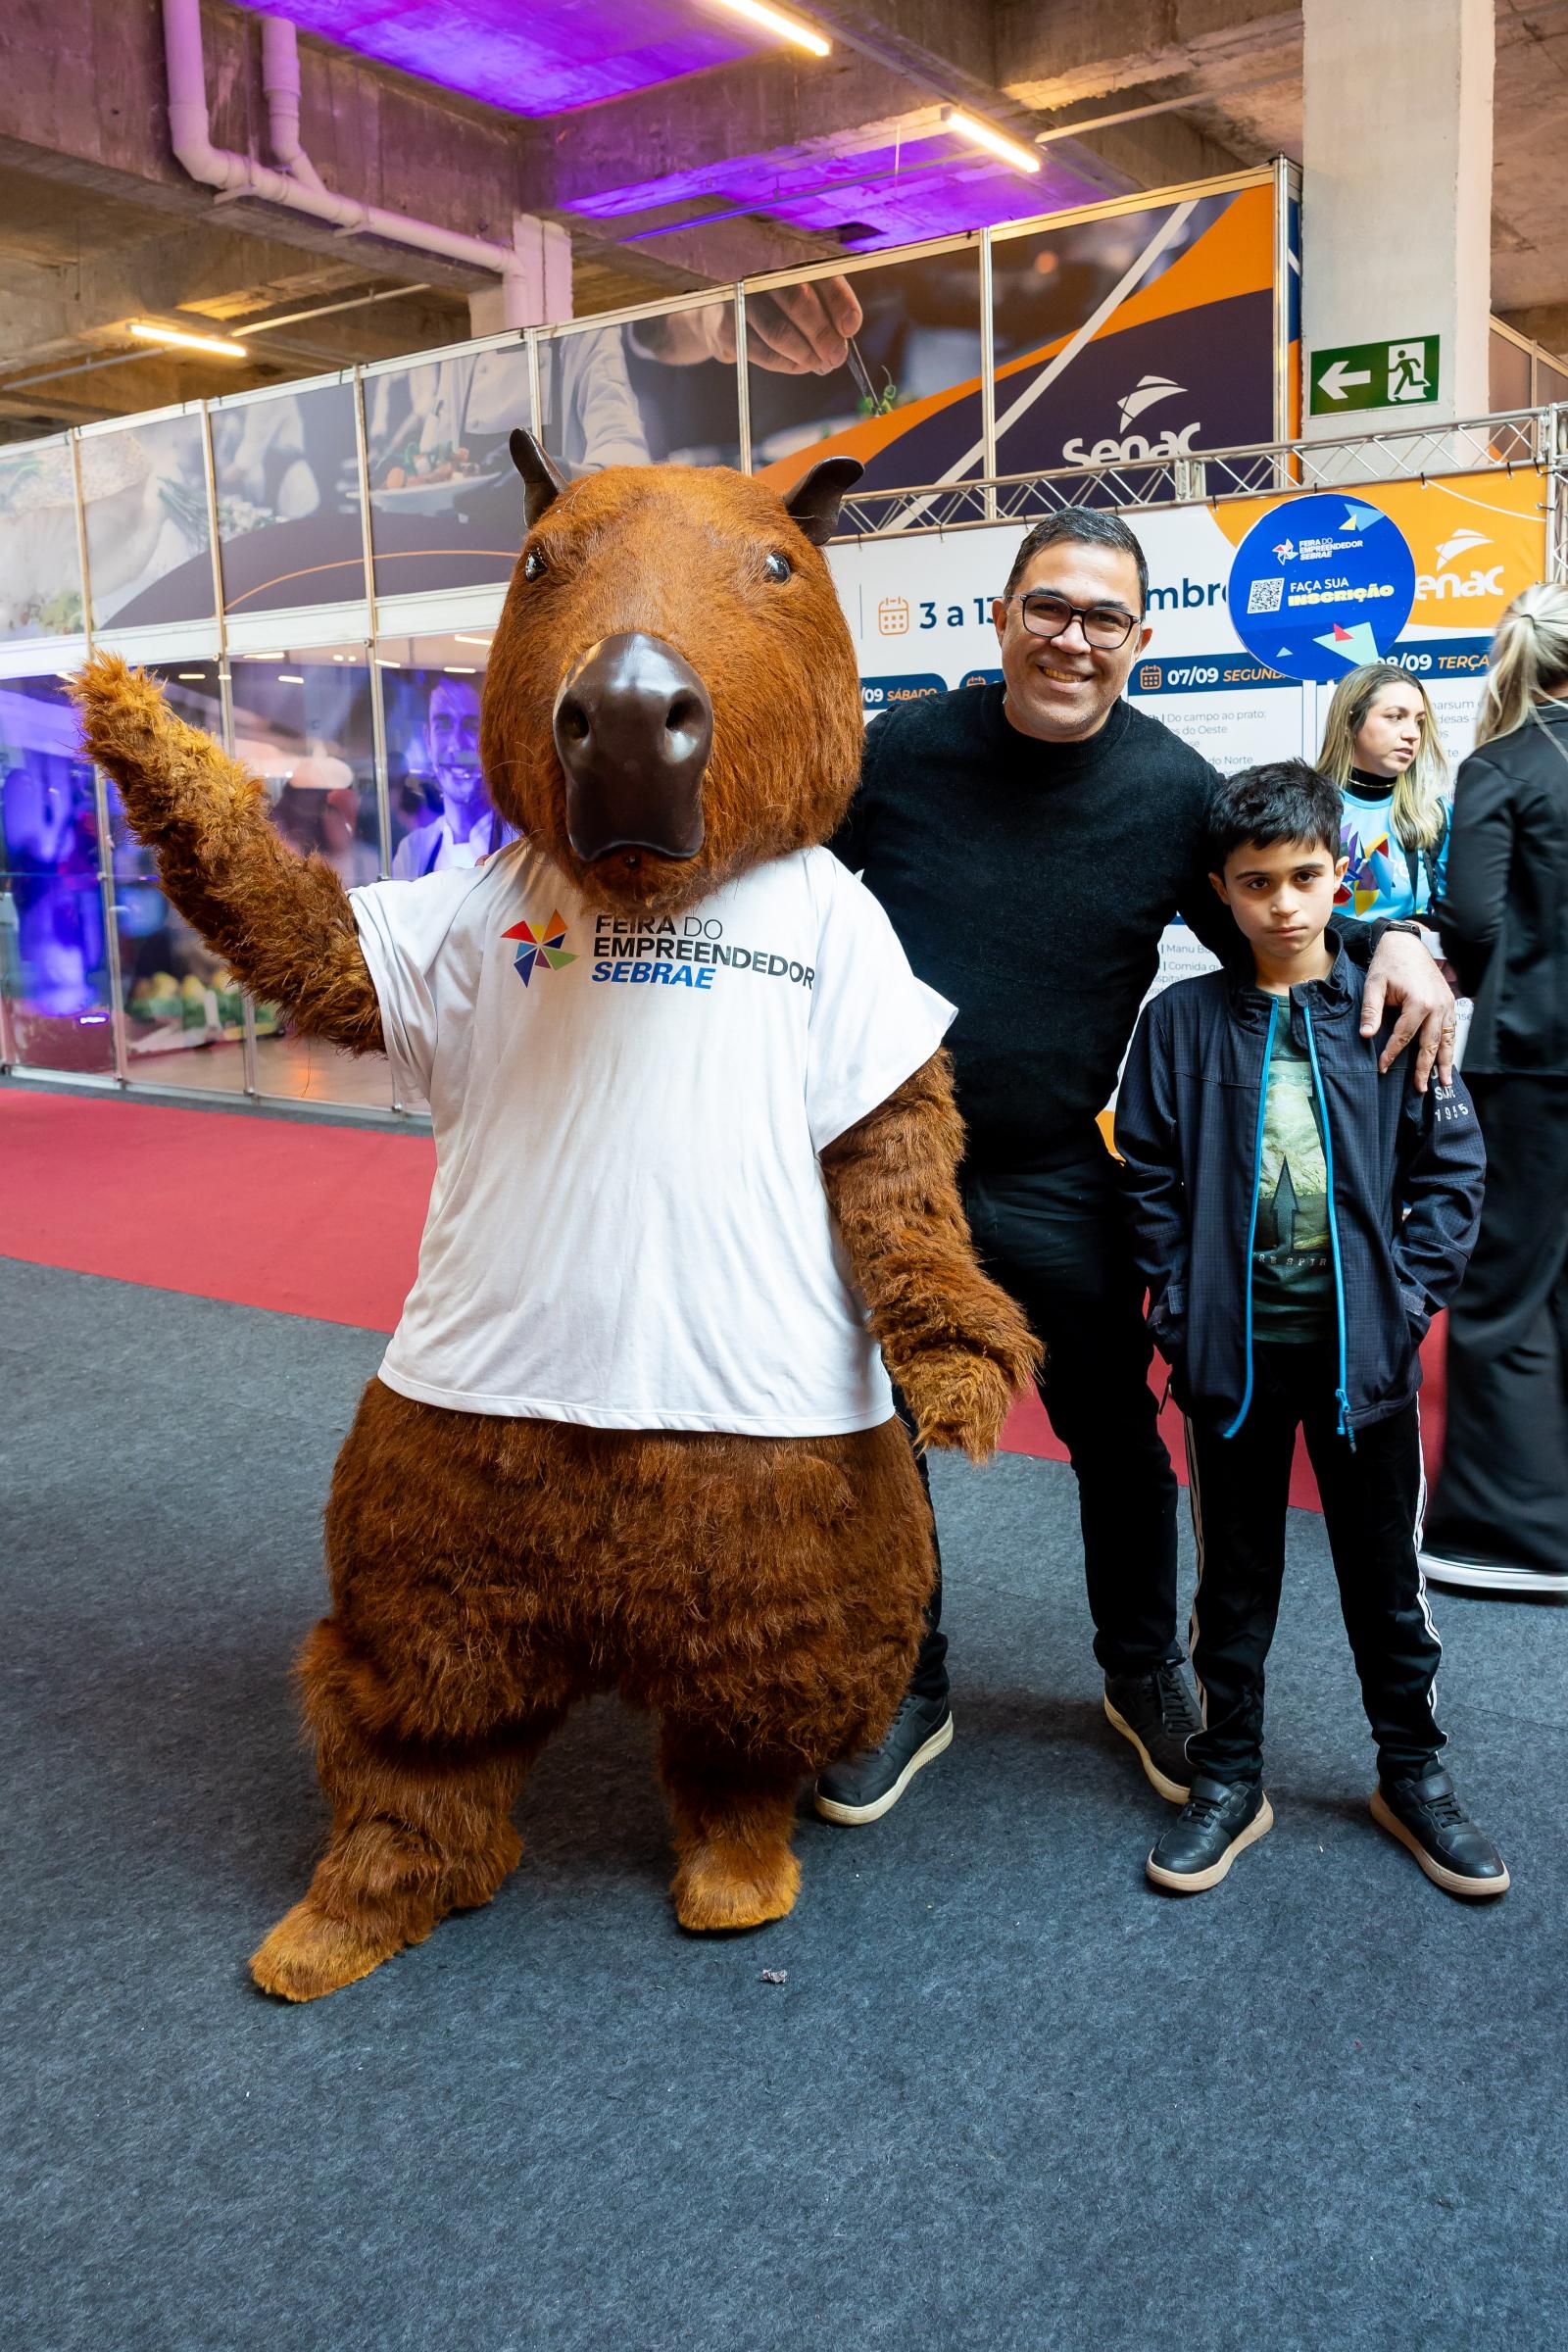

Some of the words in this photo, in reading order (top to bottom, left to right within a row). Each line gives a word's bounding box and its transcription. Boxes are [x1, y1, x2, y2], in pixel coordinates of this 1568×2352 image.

[1298, 540, 1364, 555] EMPREENDEDOR
[1299, 551, 1333, 561] SEBRAE
[1290, 581, 1322, 594] FAÇA
[1324, 577, 1349, 589] SUA
[1288, 583, 1395, 607] INSCRIÇÃO
[919, 601, 938, 630] 3
[947, 605, 964, 627] a
[1438, 655, 1491, 671] TERÇA
[1167, 666, 1219, 686] 07/09
[1223, 668, 1286, 682] SEGUND
[1167, 713, 1182, 723] Do
[1184, 712, 1221, 723] campo
[1182, 725, 1196, 735] do
[1198, 724, 1228, 735] Oeste
[1224, 756, 1253, 764] Norte
[595, 913, 677, 936] FEIRA
[683, 916, 723, 940] DO
[1166, 945, 1195, 954] Manu
[593, 937, 815, 990] EMPREENDEDOR
[1168, 961, 1207, 971] Comida
[591, 961, 716, 990] SEBRAE
